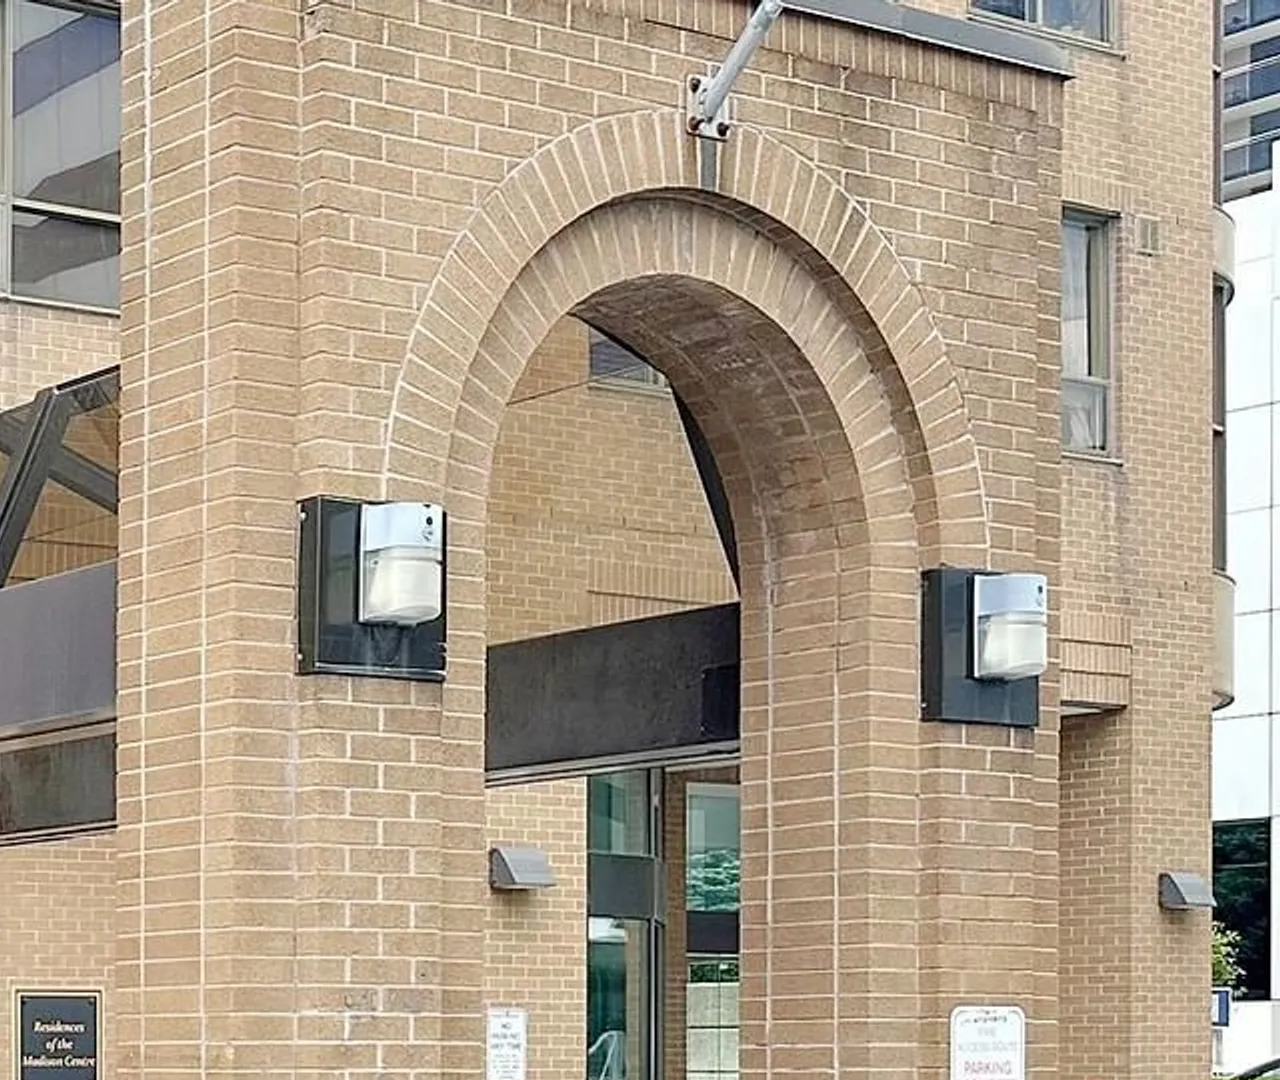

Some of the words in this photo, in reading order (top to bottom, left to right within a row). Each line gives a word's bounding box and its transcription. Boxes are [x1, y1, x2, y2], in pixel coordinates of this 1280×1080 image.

[33, 1019, 85, 1034] Residences
[45, 1037, 57, 1053] of
[57, 1037, 74, 1050] the
[22, 1055, 63, 1068] Madison
[64, 1054, 96, 1068] Centre
[963, 1060, 1013, 1075] PARKING
